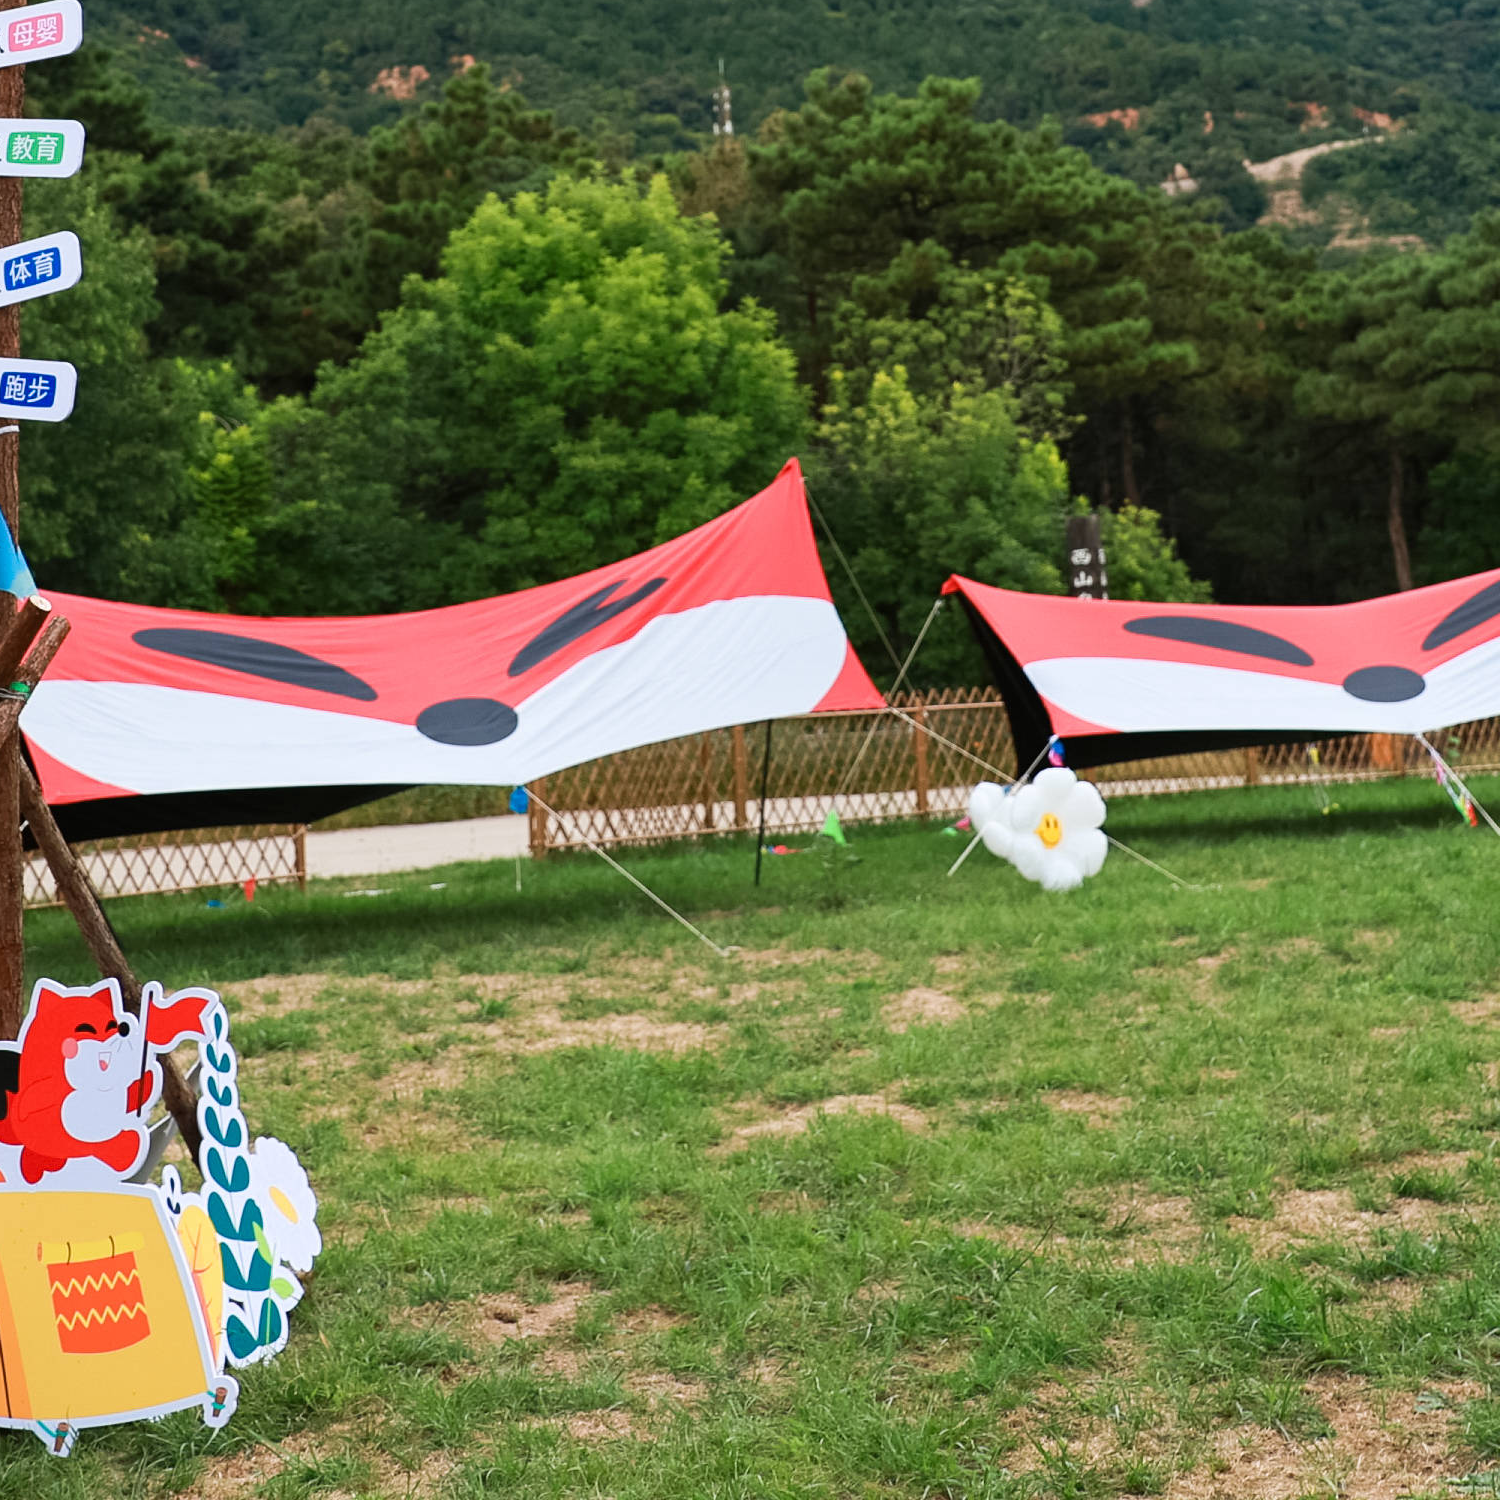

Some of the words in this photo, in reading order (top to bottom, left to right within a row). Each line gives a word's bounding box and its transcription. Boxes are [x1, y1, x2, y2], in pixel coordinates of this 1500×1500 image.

[12, 14, 58, 48] 母婴
[10, 134, 60, 163] 教育
[9, 251, 56, 287] 体育
[3, 374, 50, 403] 跑步
